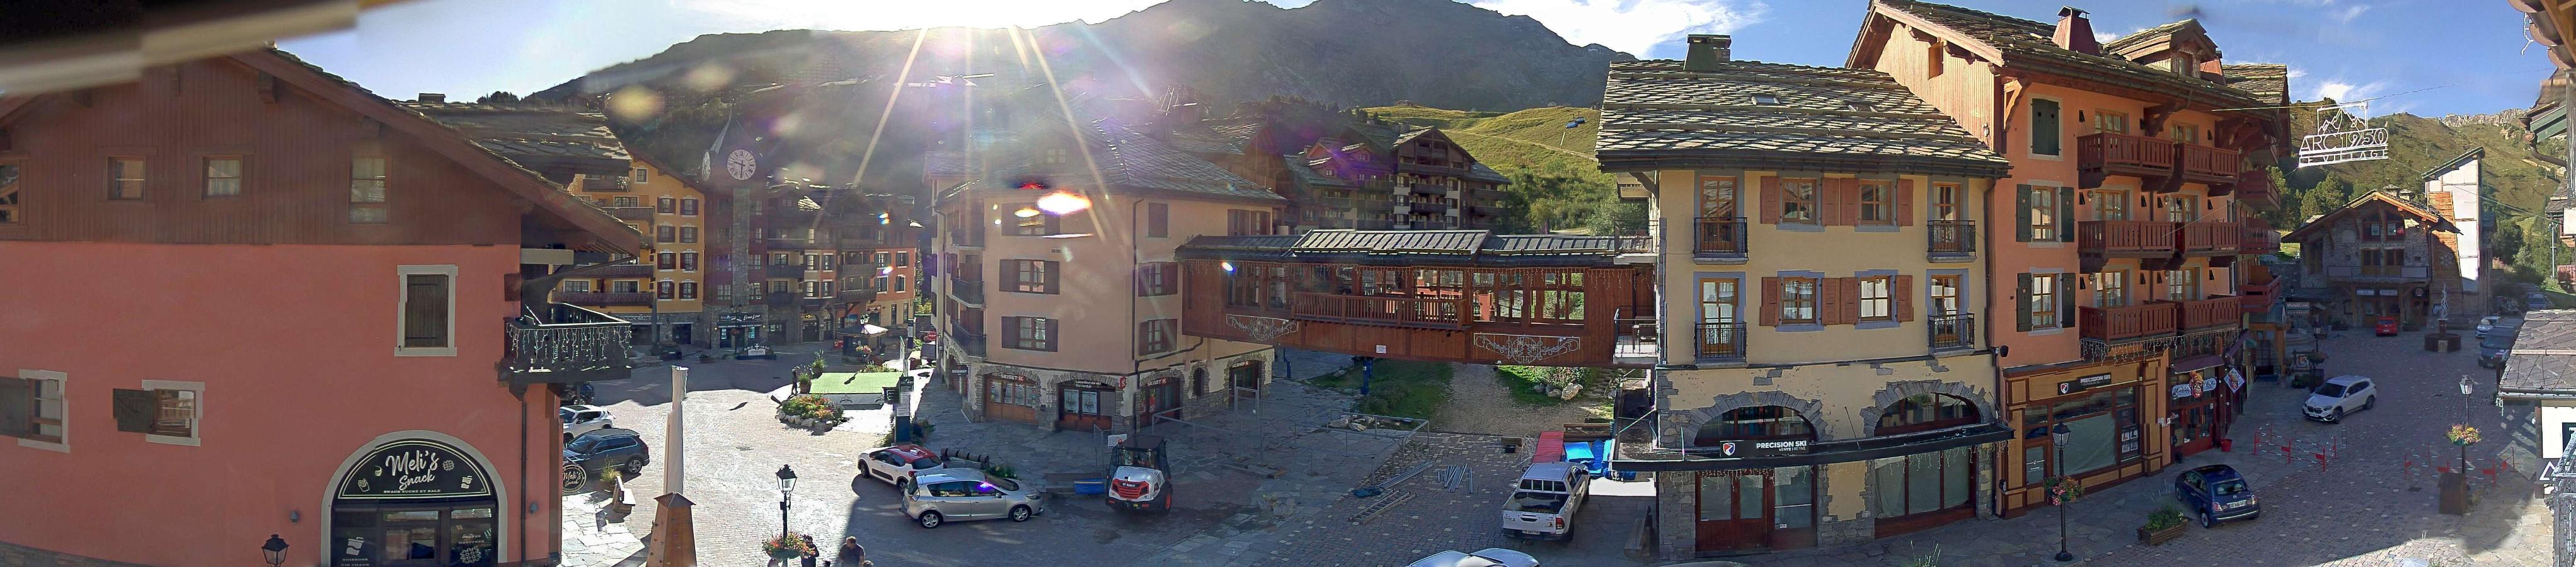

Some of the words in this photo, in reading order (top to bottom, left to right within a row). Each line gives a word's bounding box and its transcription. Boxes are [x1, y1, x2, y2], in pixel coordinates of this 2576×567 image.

[2300, 135, 2337, 152] ARC
[2340, 128, 2388, 149] 1950
[2323, 149, 2388, 161] VILLAGE
[2080, 375, 2103, 384] PRECISION
[1756, 441, 1794, 449] PRECISION
[385, 450, 439, 476] Meli's
[399, 468, 435, 491] Snack
